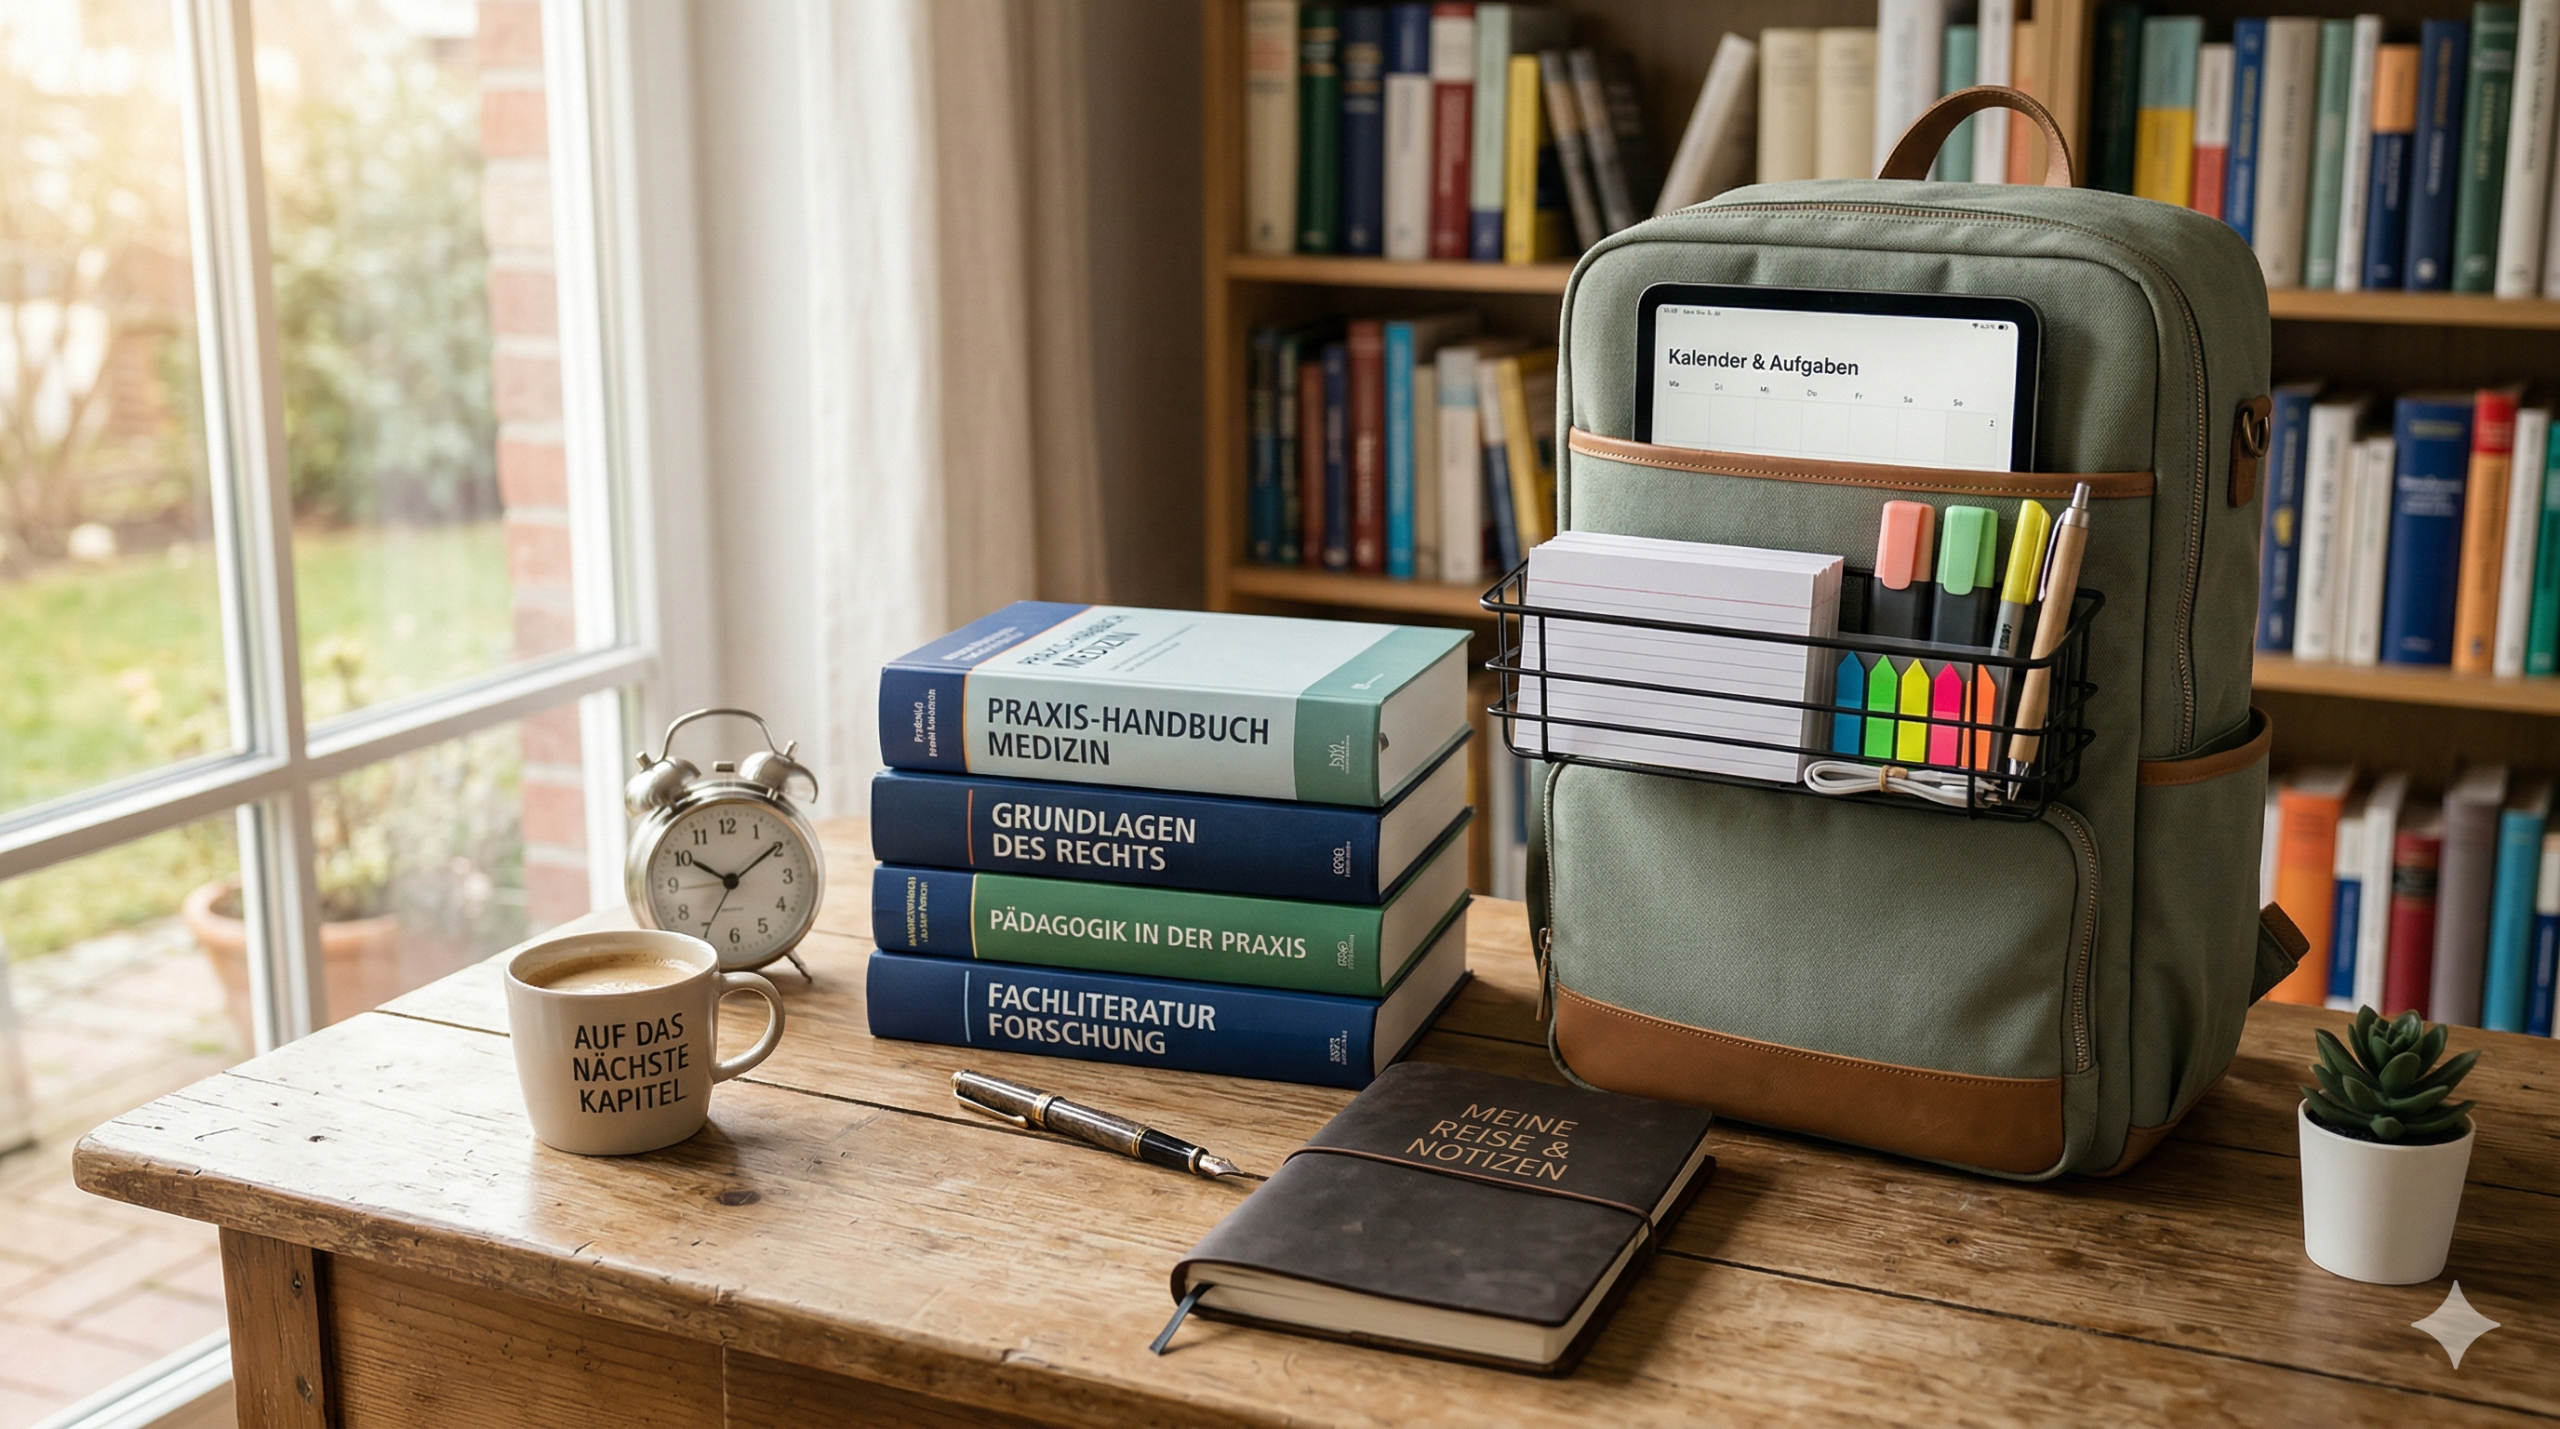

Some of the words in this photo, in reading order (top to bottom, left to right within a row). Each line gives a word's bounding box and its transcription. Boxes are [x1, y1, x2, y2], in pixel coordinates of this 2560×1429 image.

[1668, 348, 1747, 371] Kalender
[1752, 353, 1766, 371] &
[1769, 355, 1860, 377] Aufgaben
[1854, 392, 1863, 400] Fr
[987, 697, 1270, 745] PRAXIS-HANDBUCH
[987, 731, 1111, 766] MEDIZIN
[692, 828, 709, 846] 11
[718, 817, 737, 835] 12
[752, 823, 760, 840] 1
[992, 803, 1195, 843] GRUNDLAGEN
[674, 849, 693, 867] 10
[772, 841, 784, 858] 2
[992, 832, 1047, 862] DES
[1056, 839, 1166, 872] RECHTS
[667, 876, 680, 894] 9
[782, 868, 794, 885] 3
[678, 904, 690, 921] 8
[775, 896, 787, 912] 4
[701, 922, 712, 939] 7
[729, 927, 741, 944] 6
[757, 917, 768, 934] 5
[989, 907, 1128, 943] PÄDAGOGIK
[1134, 922, 1159, 945] IN
[1167, 925, 1214, 951] DER
[1221, 930, 1307, 960] PRAXIS
[988, 983, 1215, 1031] FACHLITERATUR
[573, 1023, 627, 1050] AUF
[635, 1012, 685, 1047] DAS
[988, 1014, 1166, 1056] FORSCHUNG
[572, 1043, 690, 1083] NÄCHSTE
[579, 1078, 689, 1114] KAPITEL
[1460, 1103, 1579, 1138] MEINE
[1429, 1119, 1536, 1152] REISE
[1542, 1140, 1570, 1160] &
[1405, 1138, 1568, 1181] NOTIZEN
